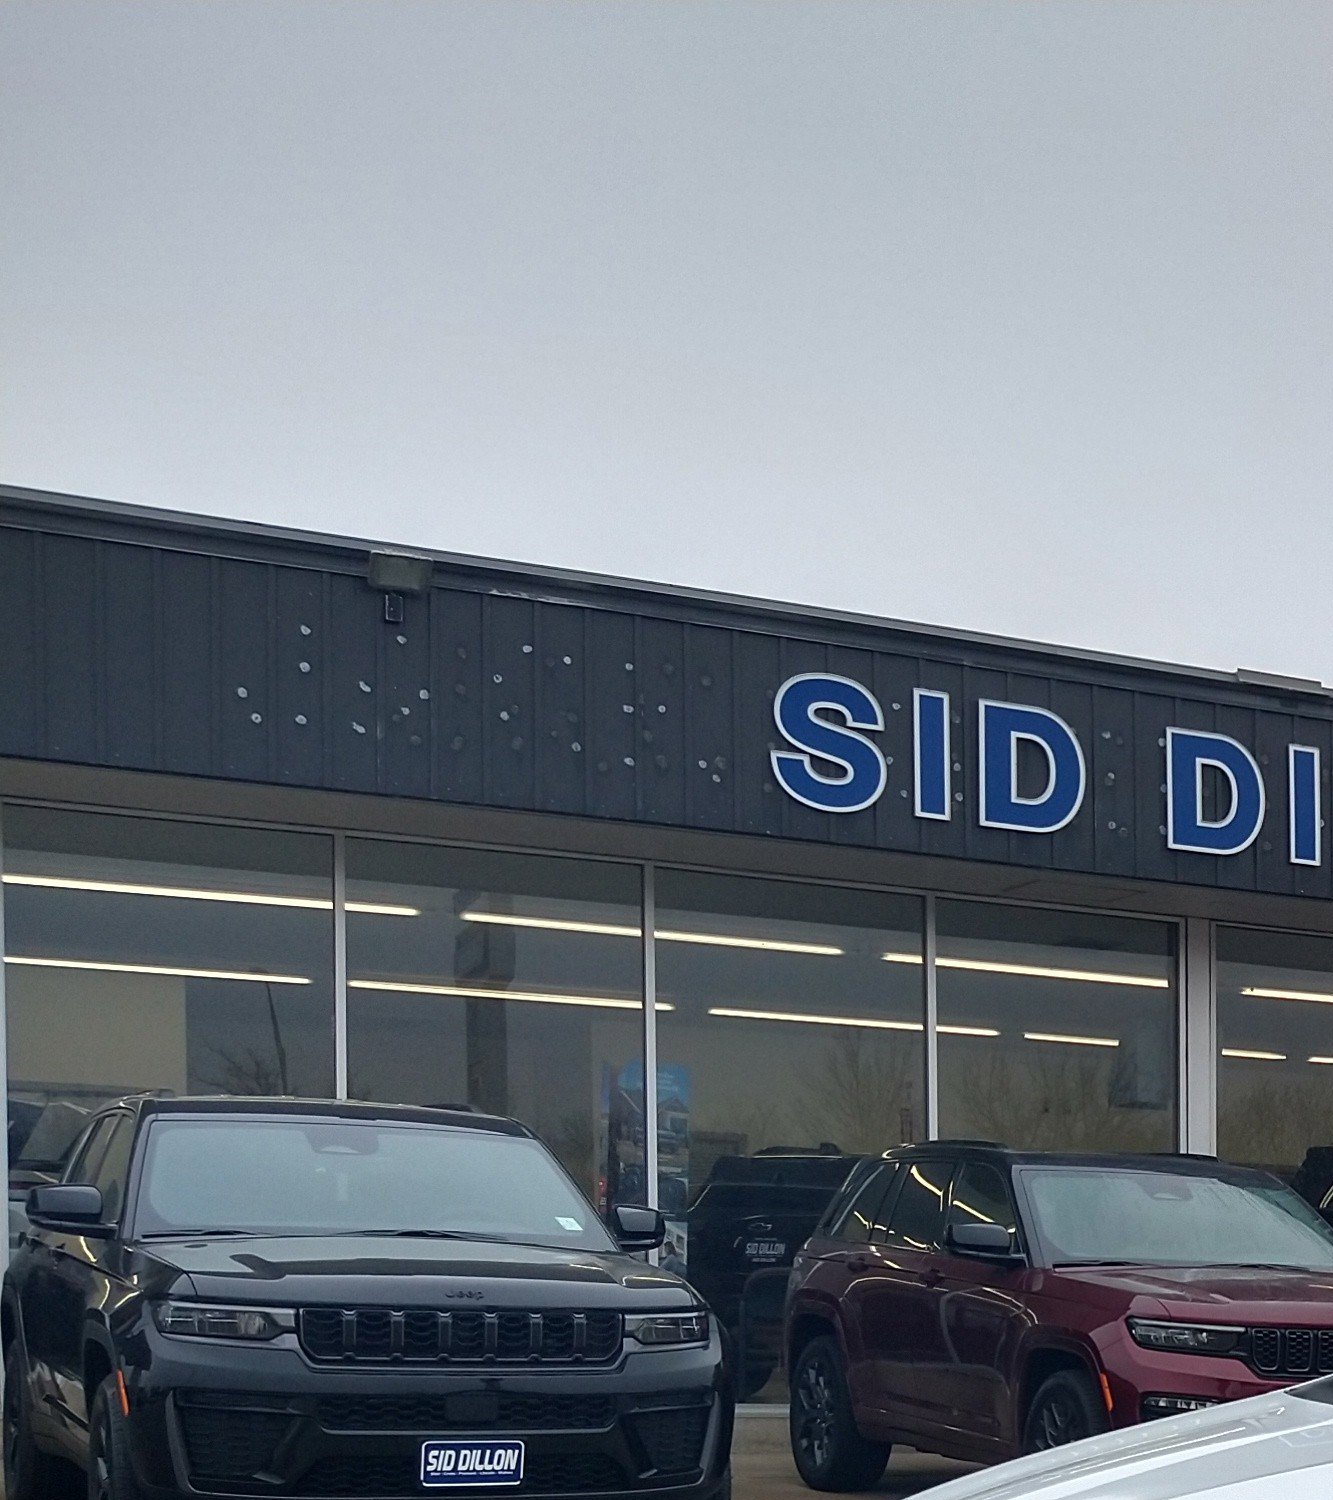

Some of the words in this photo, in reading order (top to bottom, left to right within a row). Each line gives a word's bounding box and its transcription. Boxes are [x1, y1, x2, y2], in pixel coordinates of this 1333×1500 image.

[769, 672, 1085, 834] SID
[426, 1450, 456, 1471] SID
[457, 1449, 520, 1471] DILLON
